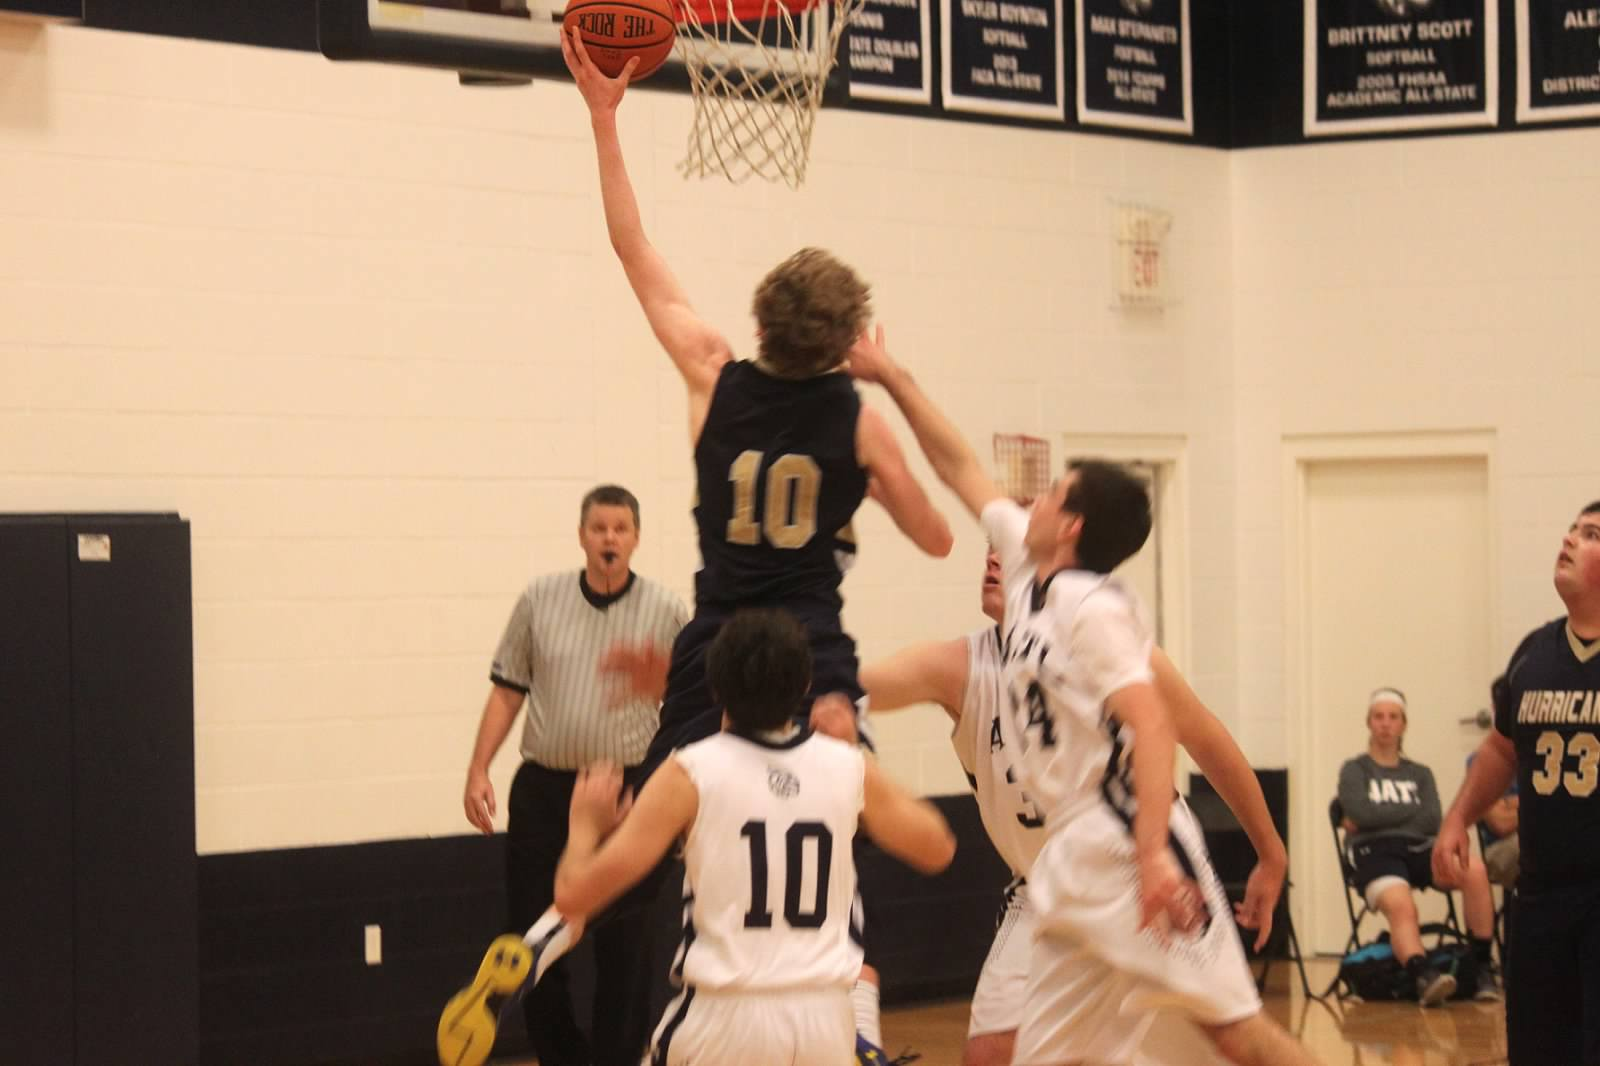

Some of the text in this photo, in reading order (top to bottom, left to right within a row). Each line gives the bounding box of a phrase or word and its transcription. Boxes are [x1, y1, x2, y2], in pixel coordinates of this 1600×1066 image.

[579, 13, 655, 38] THE ROCK
[1327, 19, 1473, 46] BRITTNEY SCOTT
[1366, 48, 1437, 66] SOFTBALL
[1327, 84, 1477, 107] ACADEMIC ALL-STATE
[726, 449, 823, 549] 10
[1532, 730, 1600, 797] 33
[740, 820, 833, 929] 10
